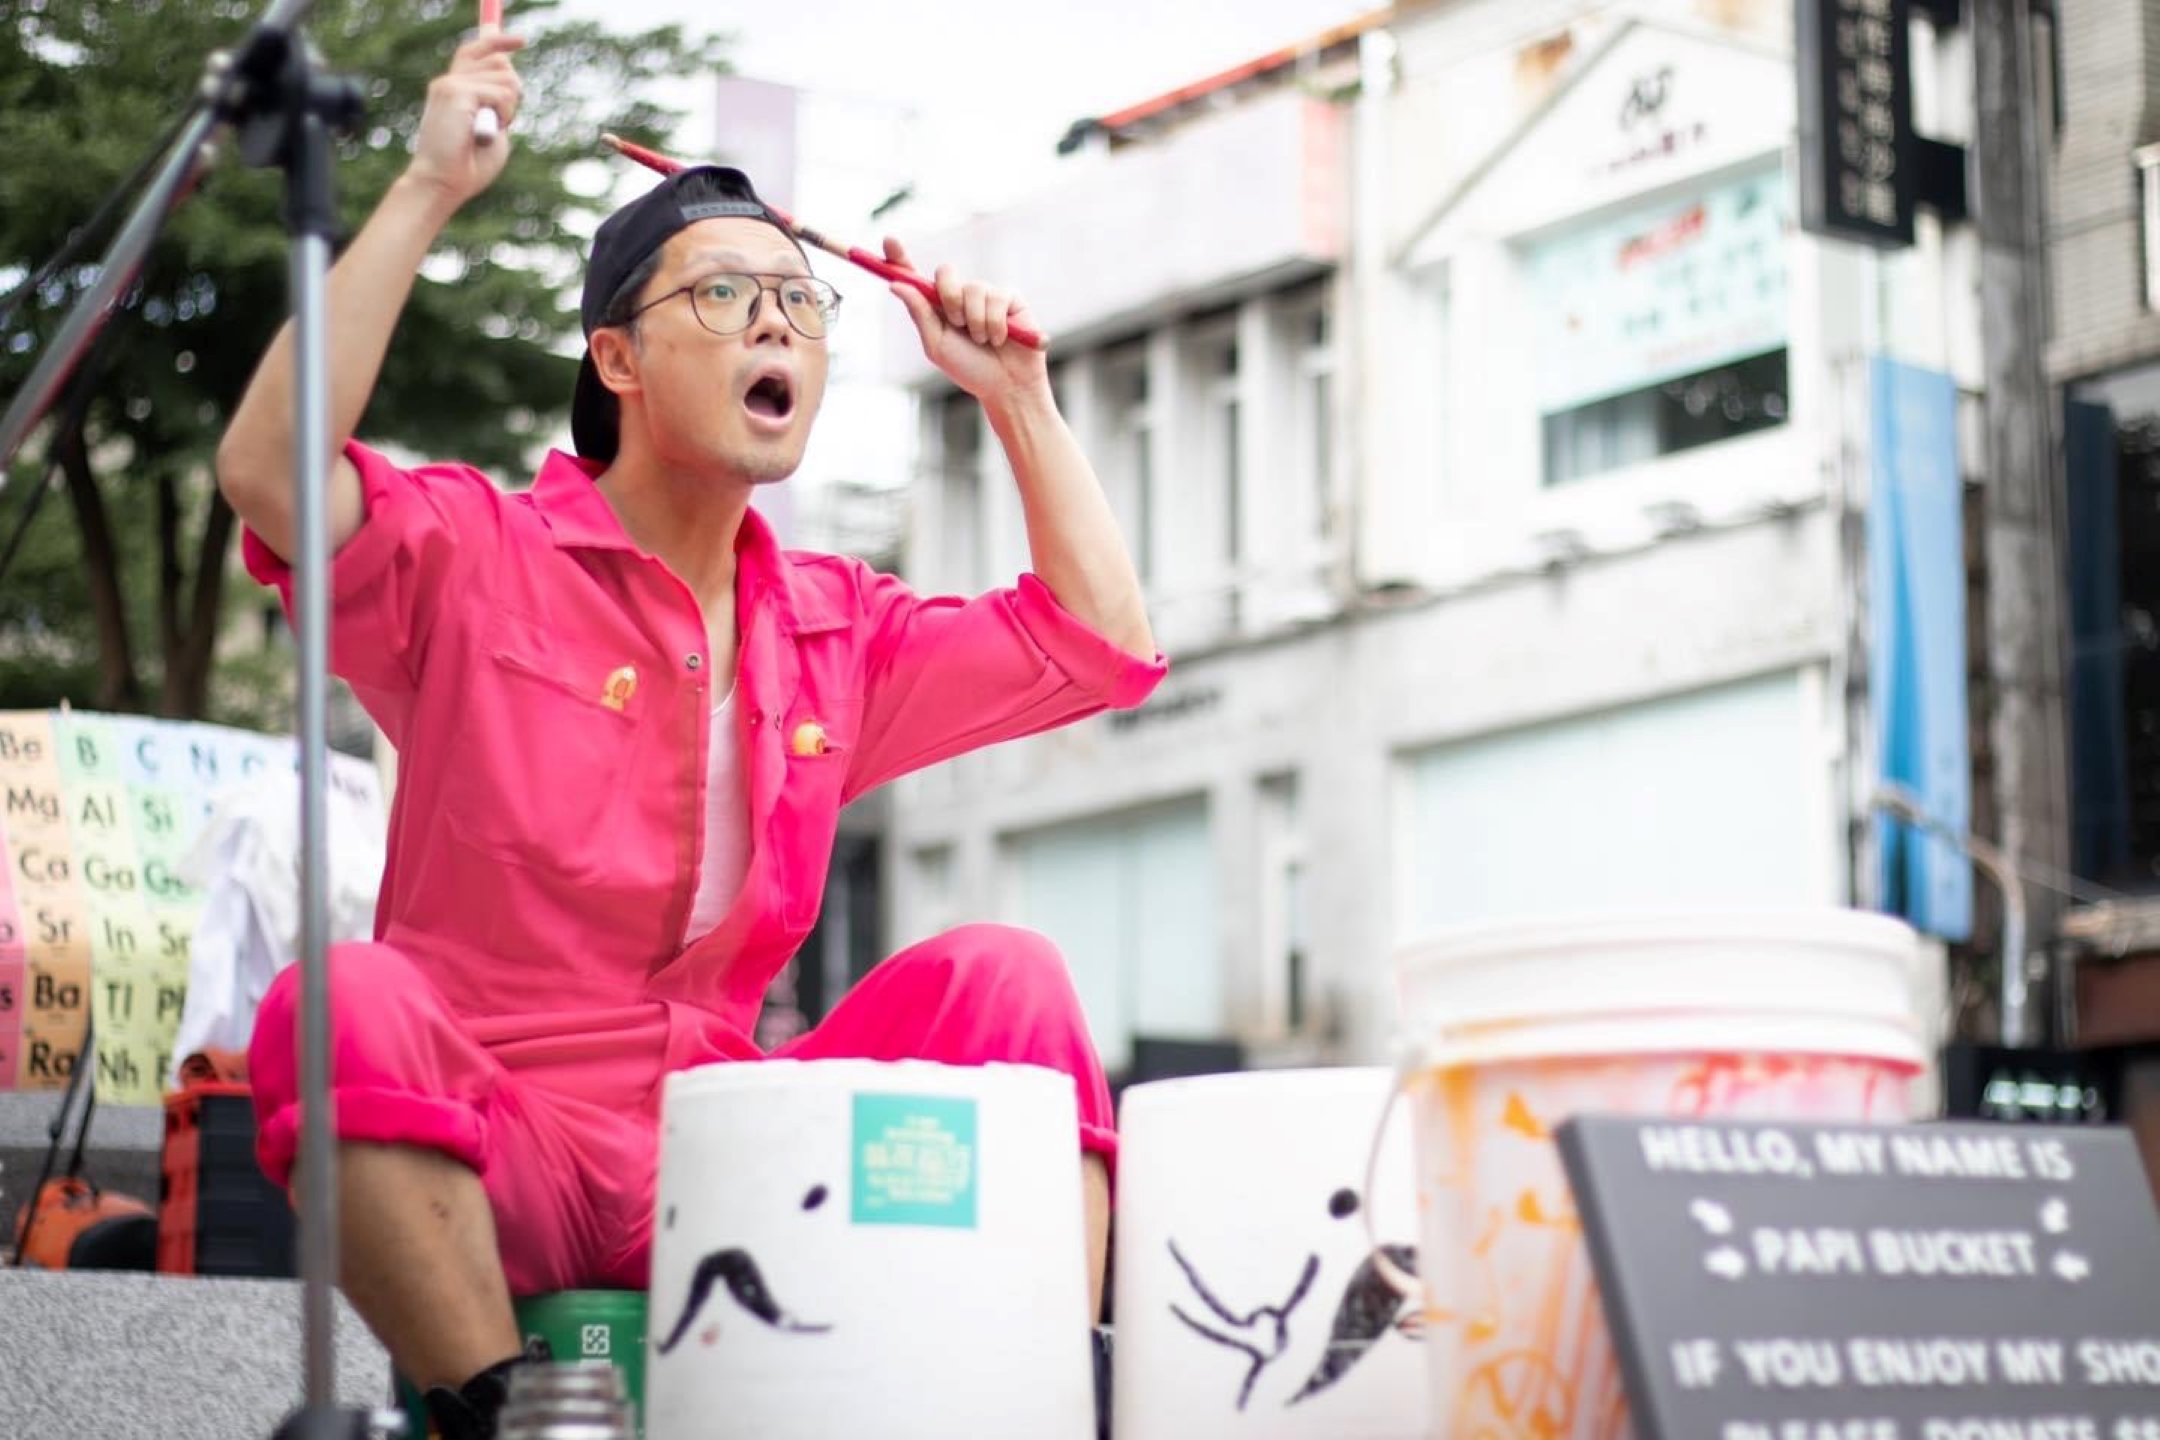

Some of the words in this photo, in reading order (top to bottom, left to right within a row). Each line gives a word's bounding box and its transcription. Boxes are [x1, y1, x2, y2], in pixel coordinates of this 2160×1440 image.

[76, 735, 98, 768] B
[7, 788, 60, 824] Mg
[37, 910, 71, 943] Sr
[35, 974, 80, 1009] Ba
[29, 1041, 75, 1078] Ra
[99, 1048, 139, 1089] Nh
[1638, 1127, 1813, 1178] HELLO,
[1815, 1131, 1886, 1175] MY
[1890, 1135, 2025, 1178] NAME
[2029, 1140, 2074, 1180] IS
[1752, 1227, 1863, 1273] PAPI
[1869, 1229, 2036, 1275] BUCKET
[1671, 1338, 1720, 1386] IF
[1736, 1338, 1841, 1386] YOU
[1848, 1338, 1988, 1385] ENJOY
[1998, 1340, 2063, 1384] MY
